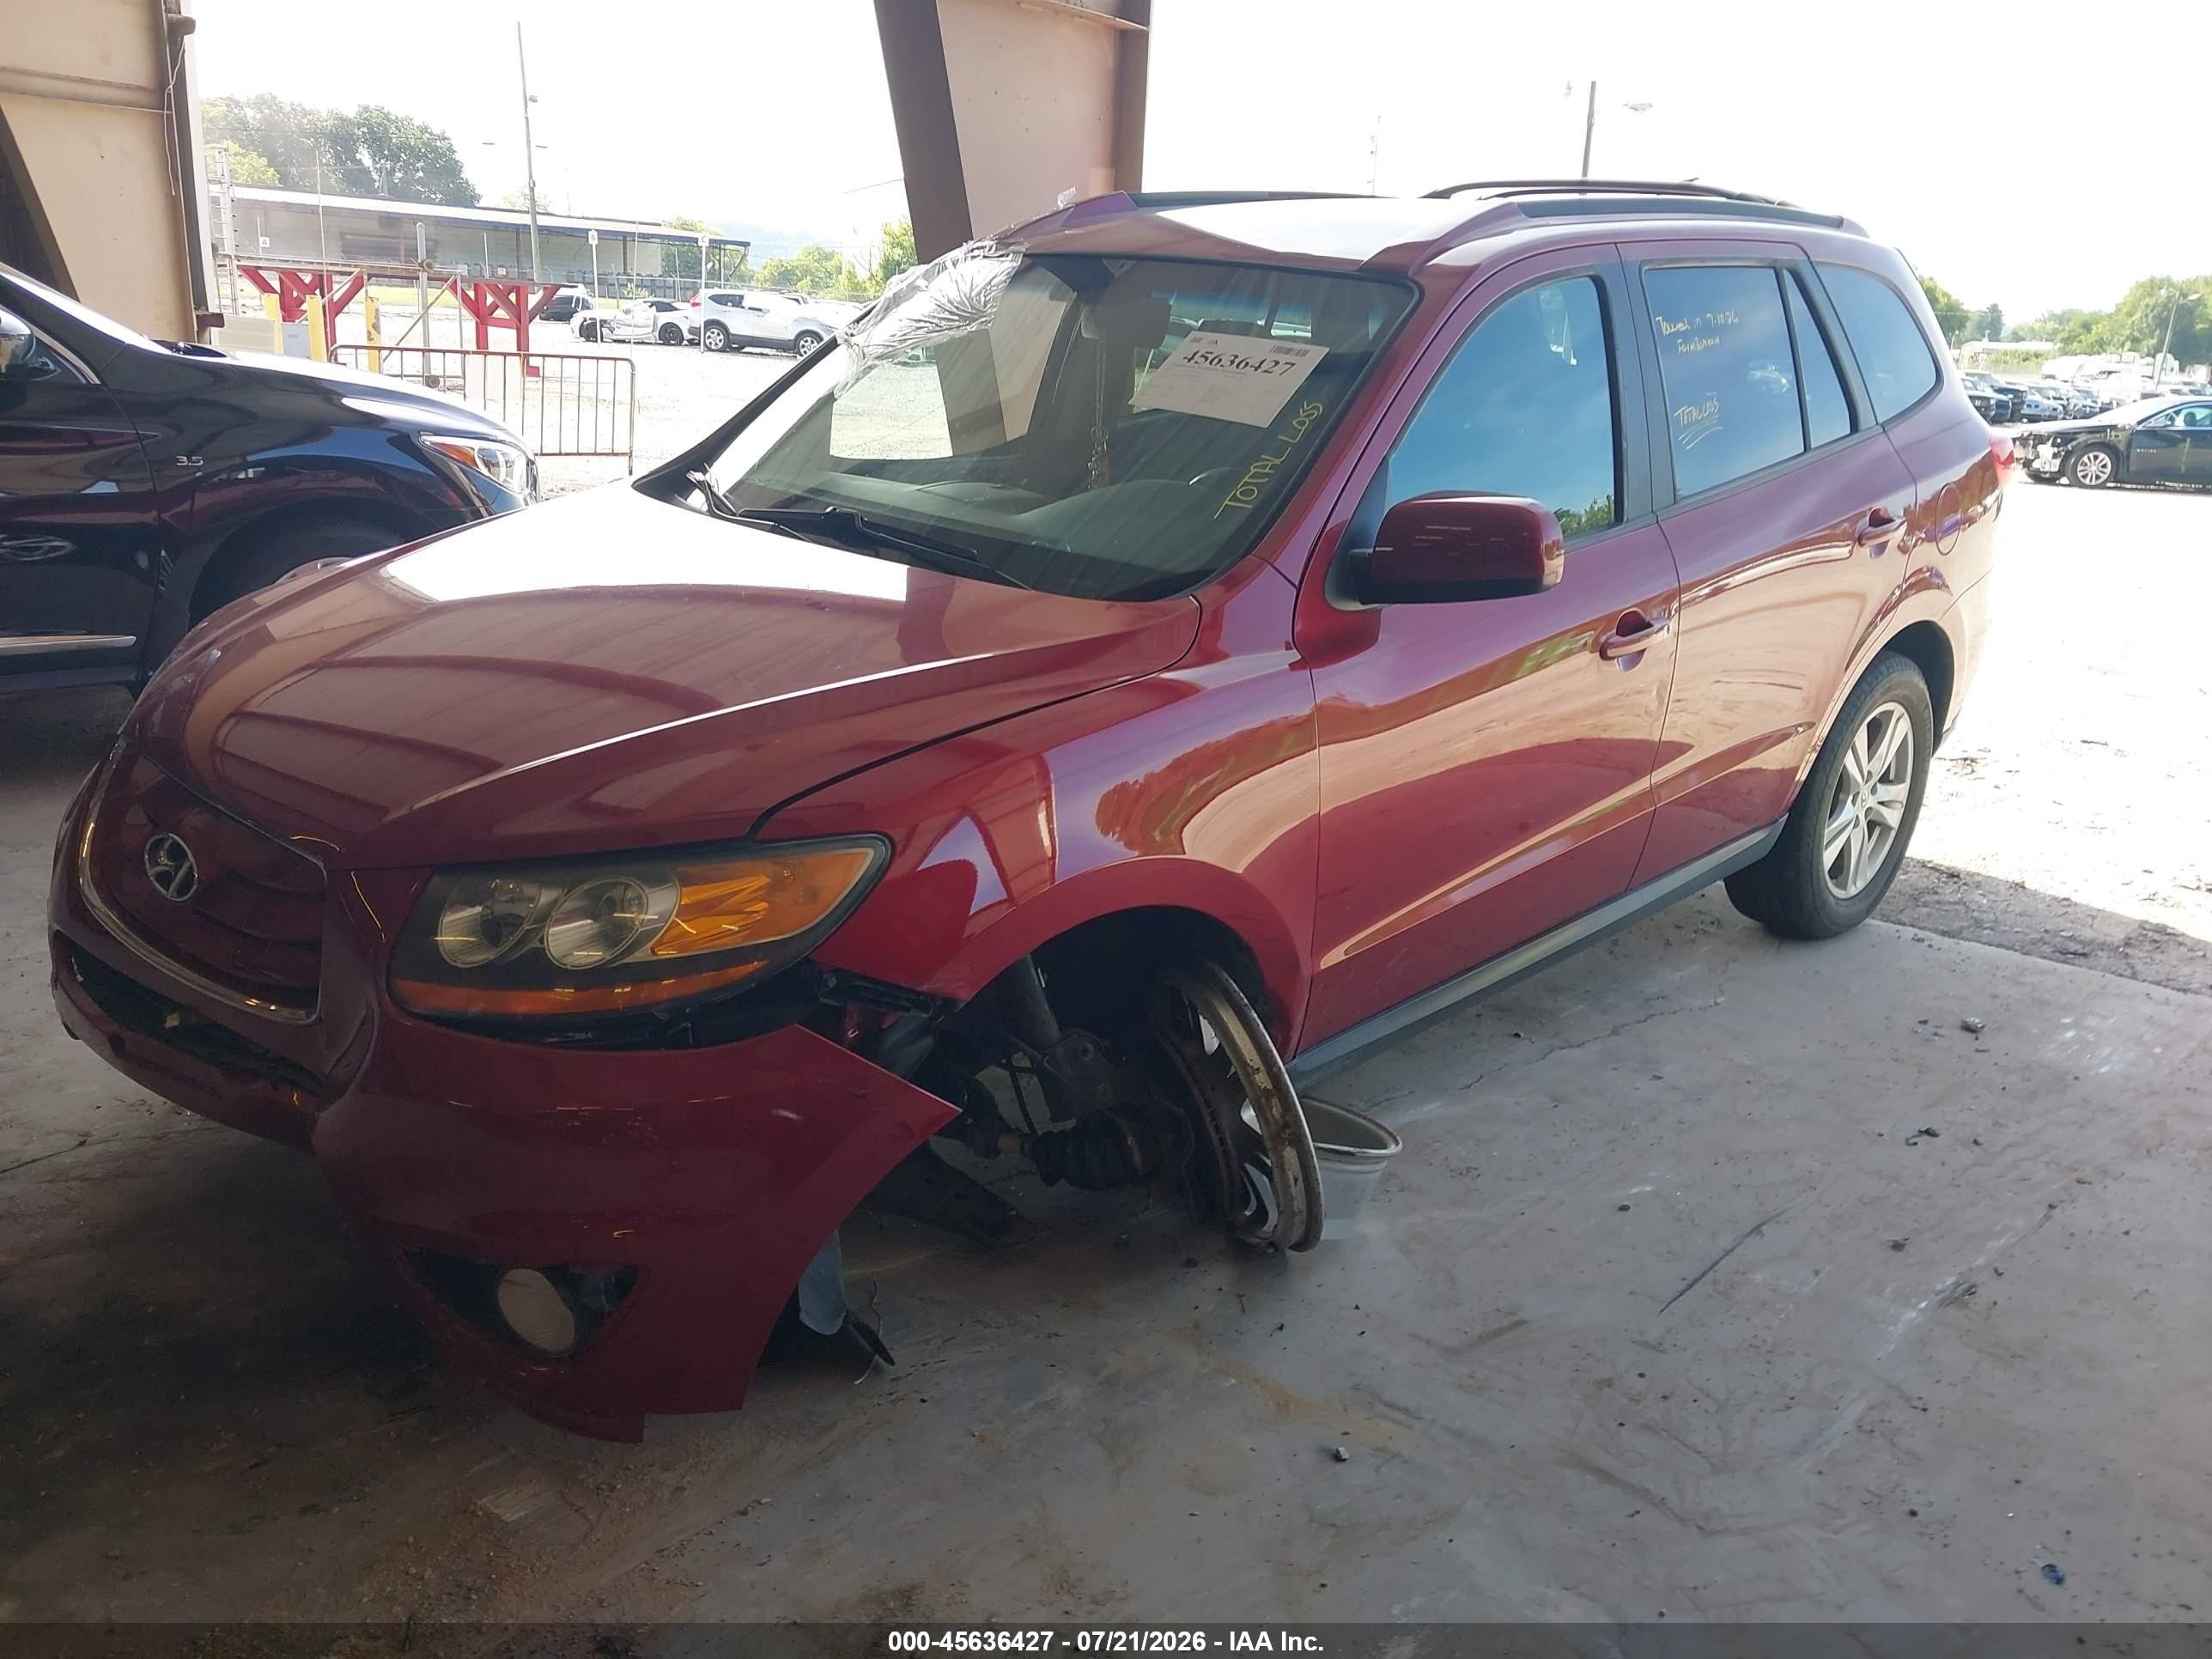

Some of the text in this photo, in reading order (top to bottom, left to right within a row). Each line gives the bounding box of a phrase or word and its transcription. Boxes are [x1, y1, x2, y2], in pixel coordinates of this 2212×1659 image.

[1656, 316, 1691, 337] Towed
[1182, 349, 1297, 376] 45636427
[176, 455, 204, 465] 3.5
[1214, 401, 1322, 519] TOTAL LOSS
